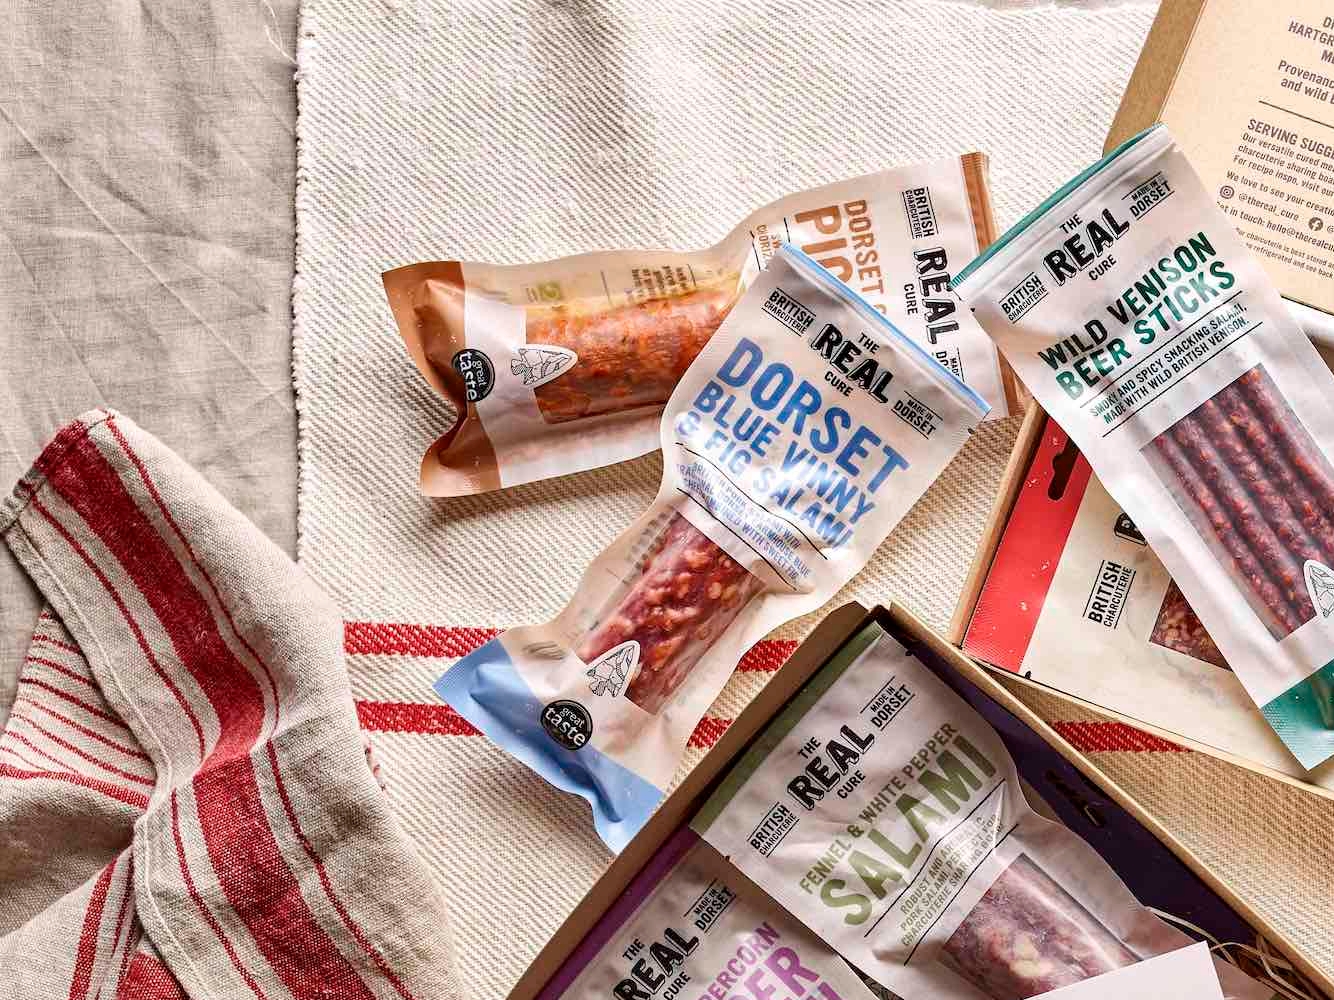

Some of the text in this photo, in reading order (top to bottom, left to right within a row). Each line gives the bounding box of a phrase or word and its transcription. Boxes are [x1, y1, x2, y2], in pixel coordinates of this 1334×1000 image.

[1247, 118, 1299, 146] SERVING
[912, 187, 935, 238] BRITISH
[1129, 179, 1171, 218] DORSET
[1059, 213, 1083, 234] THE
[843, 199, 884, 294] DORSET
[1042, 208, 1130, 287] REAL
[1088, 254, 1117, 281] CURE
[768, 290, 816, 328] BRITISH
[903, 283, 919, 315] CURE
[913, 248, 960, 345] REAL
[998, 274, 1044, 315] BRITISH
[1037, 319, 1108, 371] WILD
[1105, 231, 1217, 326] VENISON
[764, 300, 808, 336] CHARCUTERIE
[1055, 337, 1133, 388] BEER
[1133, 260, 1235, 345] STICKS
[810, 323, 895, 405] REAL
[858, 333, 881, 356] THE
[824, 371, 854, 398] CURE
[716, 337, 910, 495] DORSET
[893, 400, 937, 437] DORSET
[693, 380, 782, 458] BLUE
[782, 441, 876, 525] VINNY
[676, 410, 855, 548] & FIG SALAMI
[1087, 561, 1122, 624] BRITISH
[1103, 566, 1133, 628] CHARCUTERIE
[539, 705, 593, 748] taste
[870, 683, 912, 728] DORSET
[786, 724, 875, 812] REAL
[796, 736, 822, 760] THE
[836, 769, 867, 799] CURE
[746, 804, 793, 850] BRITISH
[800, 722, 958, 895] FENNEL & WHITE PEPPER
[820, 735, 998, 927] SALAMI
[754, 812, 801, 856] CHARCUTERIE
[694, 884, 738, 931] DORSET
[622, 938, 645, 961] THE
[663, 970, 692, 1000] CURE
